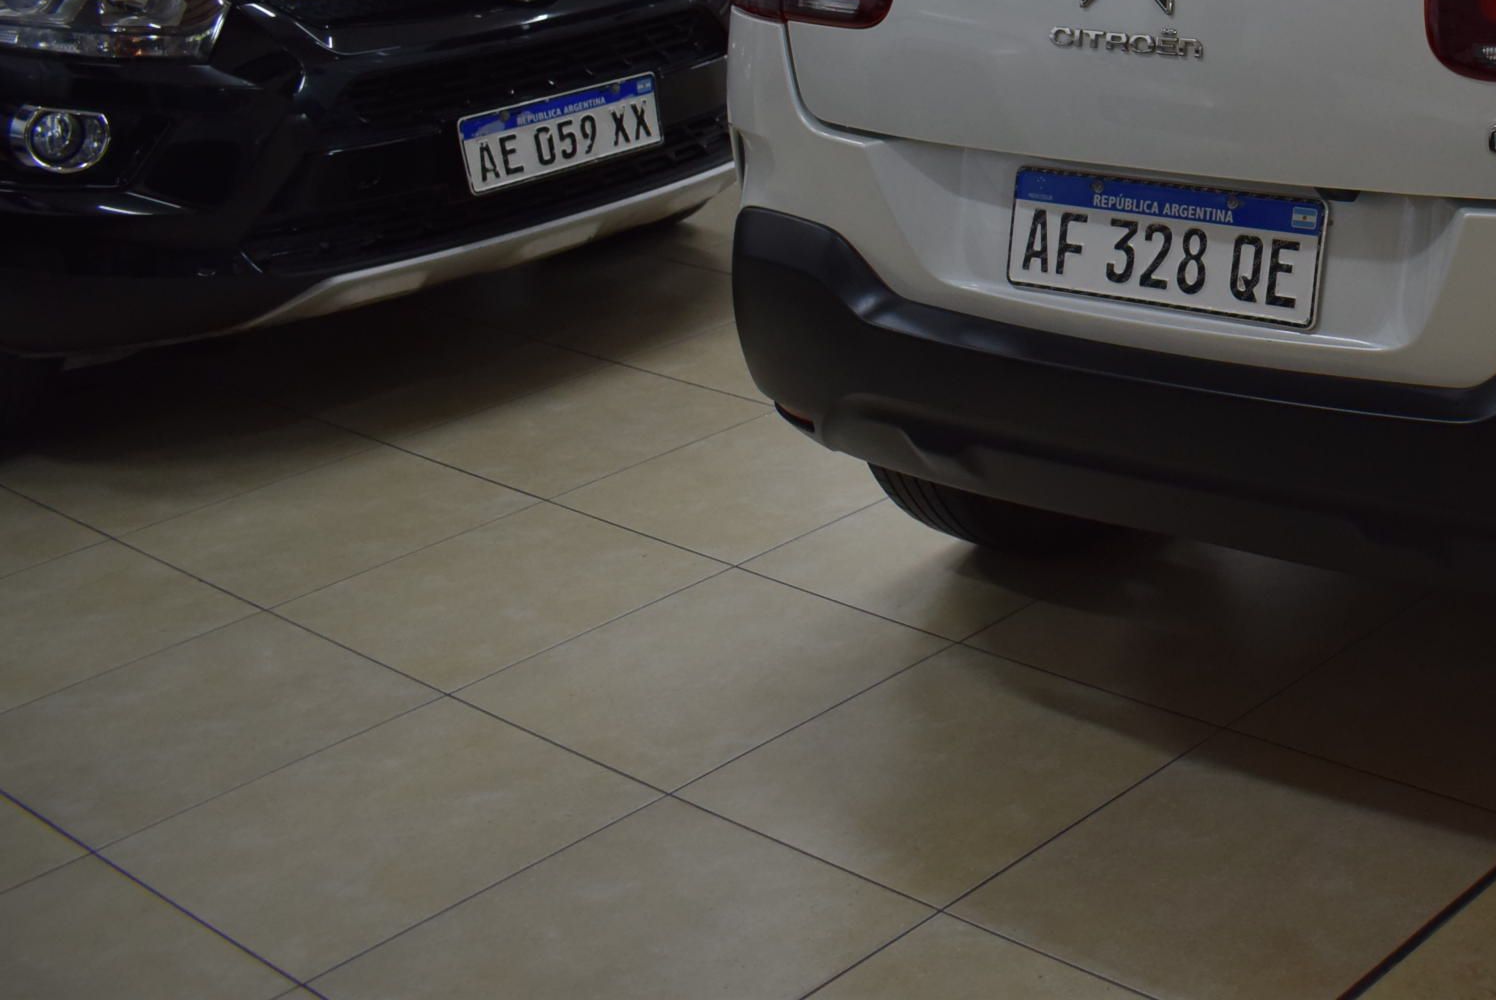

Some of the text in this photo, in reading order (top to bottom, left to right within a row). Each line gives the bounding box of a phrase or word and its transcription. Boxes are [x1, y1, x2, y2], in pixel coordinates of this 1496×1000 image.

[563, 96, 607, 114] ARGENTINA
[479, 99, 652, 183] AE 059 XX
[1092, 192, 1234, 225] REPÚBLICA ARGENTINA
[1022, 208, 1301, 309] AF 328 QE
